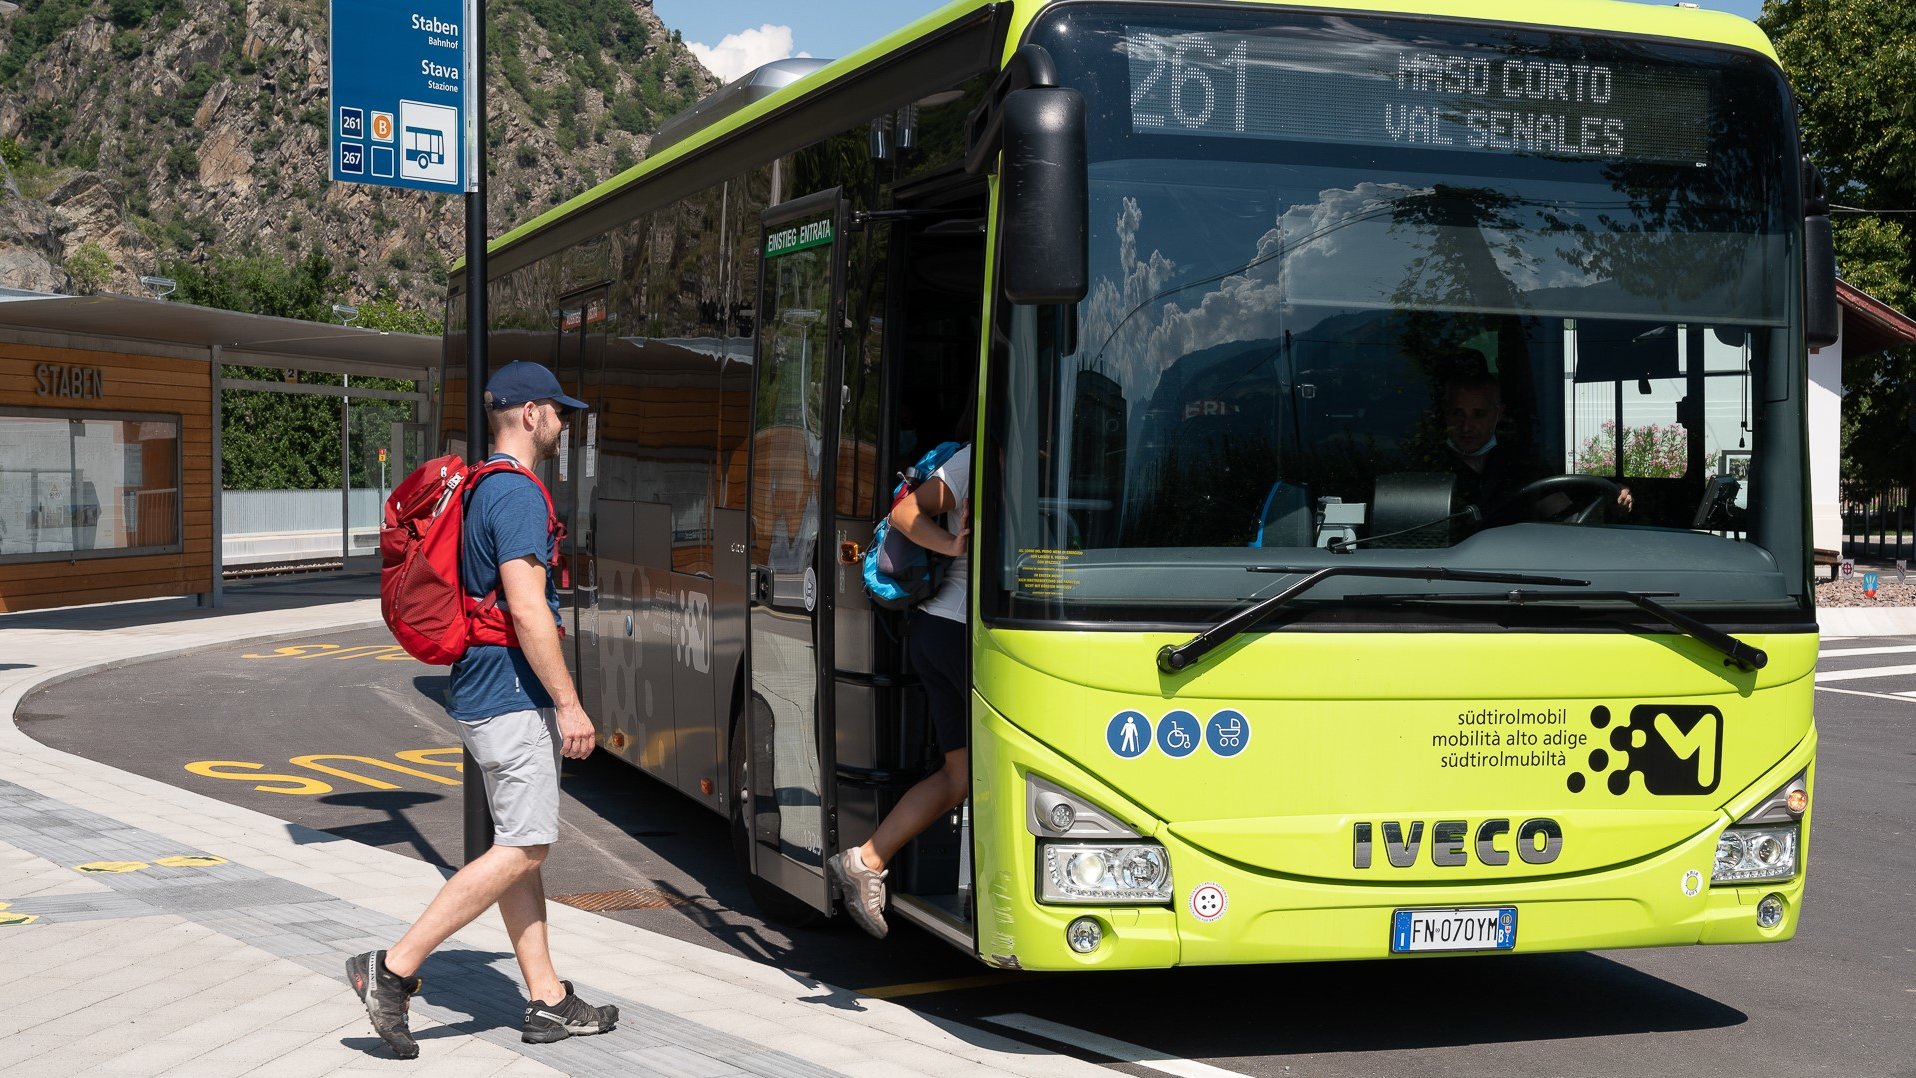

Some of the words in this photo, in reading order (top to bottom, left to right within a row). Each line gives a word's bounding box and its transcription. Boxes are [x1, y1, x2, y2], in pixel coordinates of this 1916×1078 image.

[411, 13, 458, 36] Staben
[428, 36, 459, 50] Bahnhof
[421, 59, 459, 80] Stava
[1398, 52, 1489, 97] MASO
[1503, 60, 1612, 105] CORTO
[428, 80, 459, 93] Stazione
[1130, 32, 1247, 133] 261
[343, 116, 361, 131] 261
[378, 119, 388, 136] B
[1385, 103, 1454, 146] VAL
[1466, 109, 1625, 156] SENALES
[343, 151, 361, 165] 267
[767, 227, 797, 253] EINSTIEG
[800, 219, 831, 244] ENTRATA
[35, 363, 105, 400] STABEN
[1458, 709, 1567, 725] südtirolmobil
[1432, 731, 1500, 747] mobilità
[1506, 730, 1538, 746] alto
[1543, 729, 1588, 749] adige
[1441, 751, 1567, 768] südtirolmubiltà
[1353, 817, 1563, 869] IVECO
[1412, 919, 1435, 943] FN
